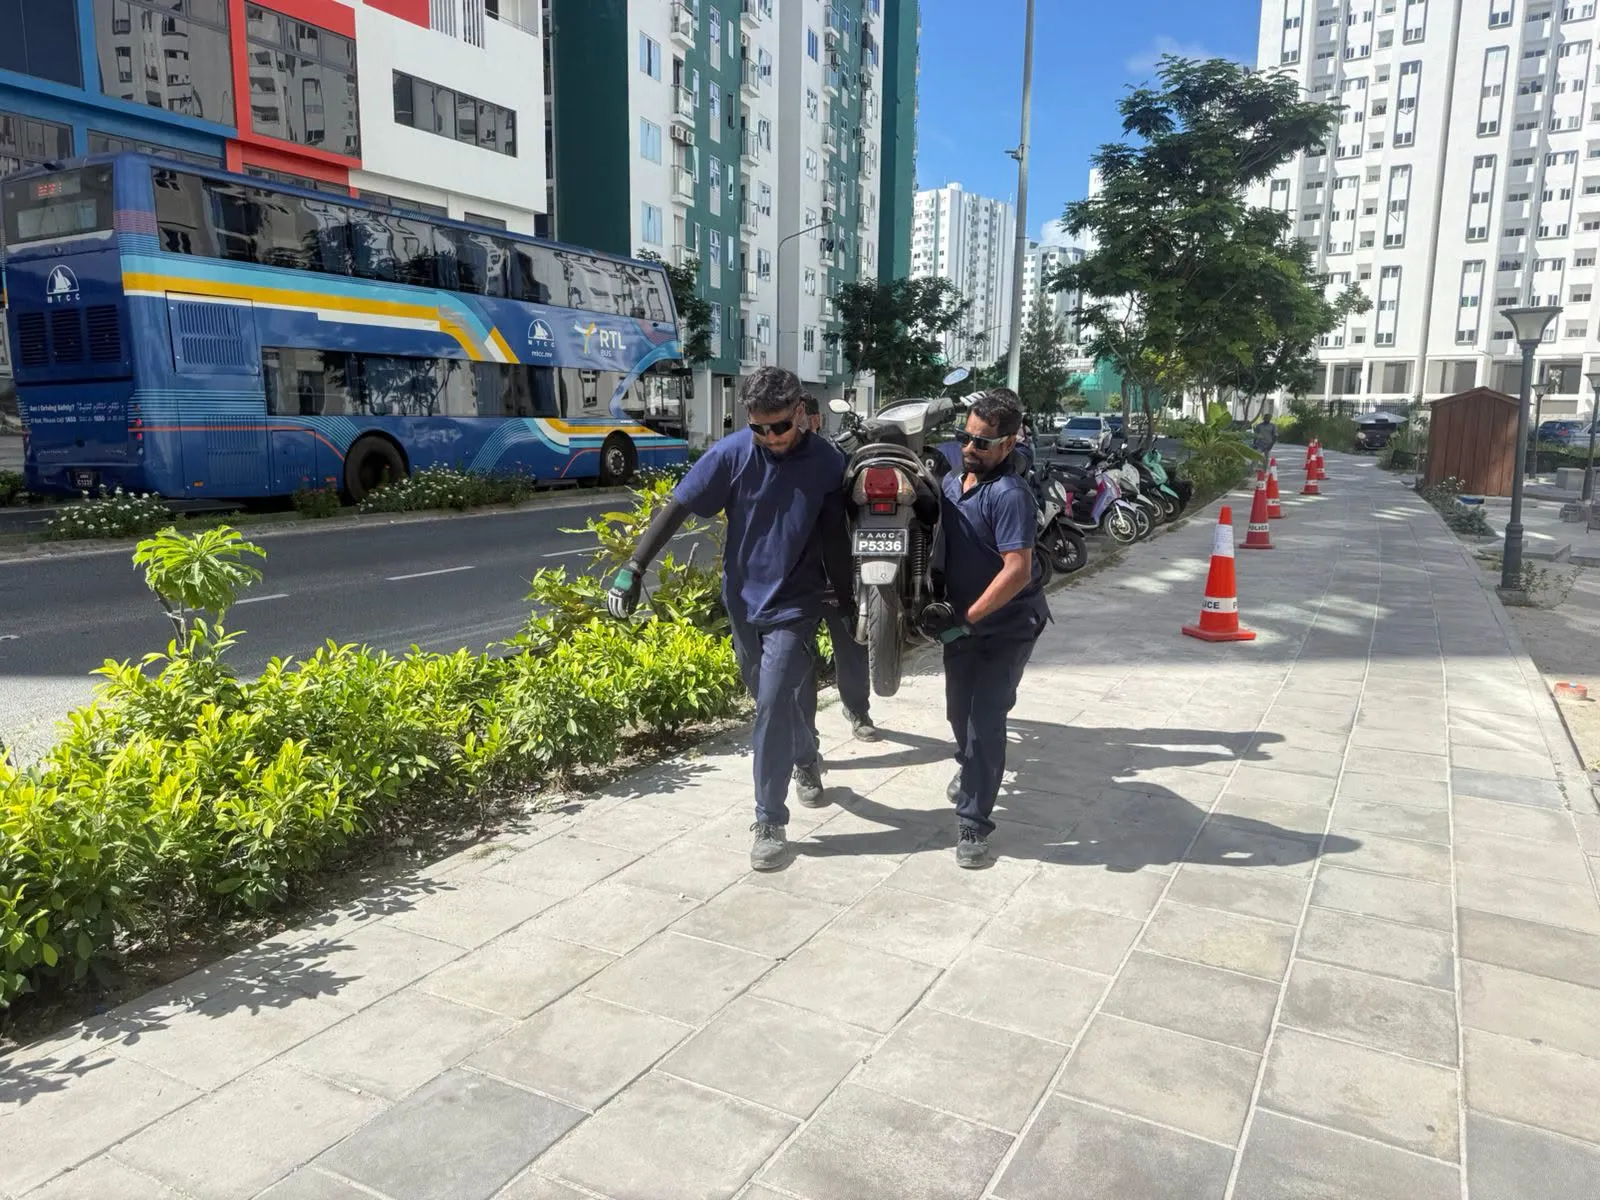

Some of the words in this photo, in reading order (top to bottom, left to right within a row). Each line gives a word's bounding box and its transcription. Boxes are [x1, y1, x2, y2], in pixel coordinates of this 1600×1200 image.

[600, 329, 626, 349] RTL
[600, 349, 612, 358] BUS
[859, 541, 902, 551] P5336
